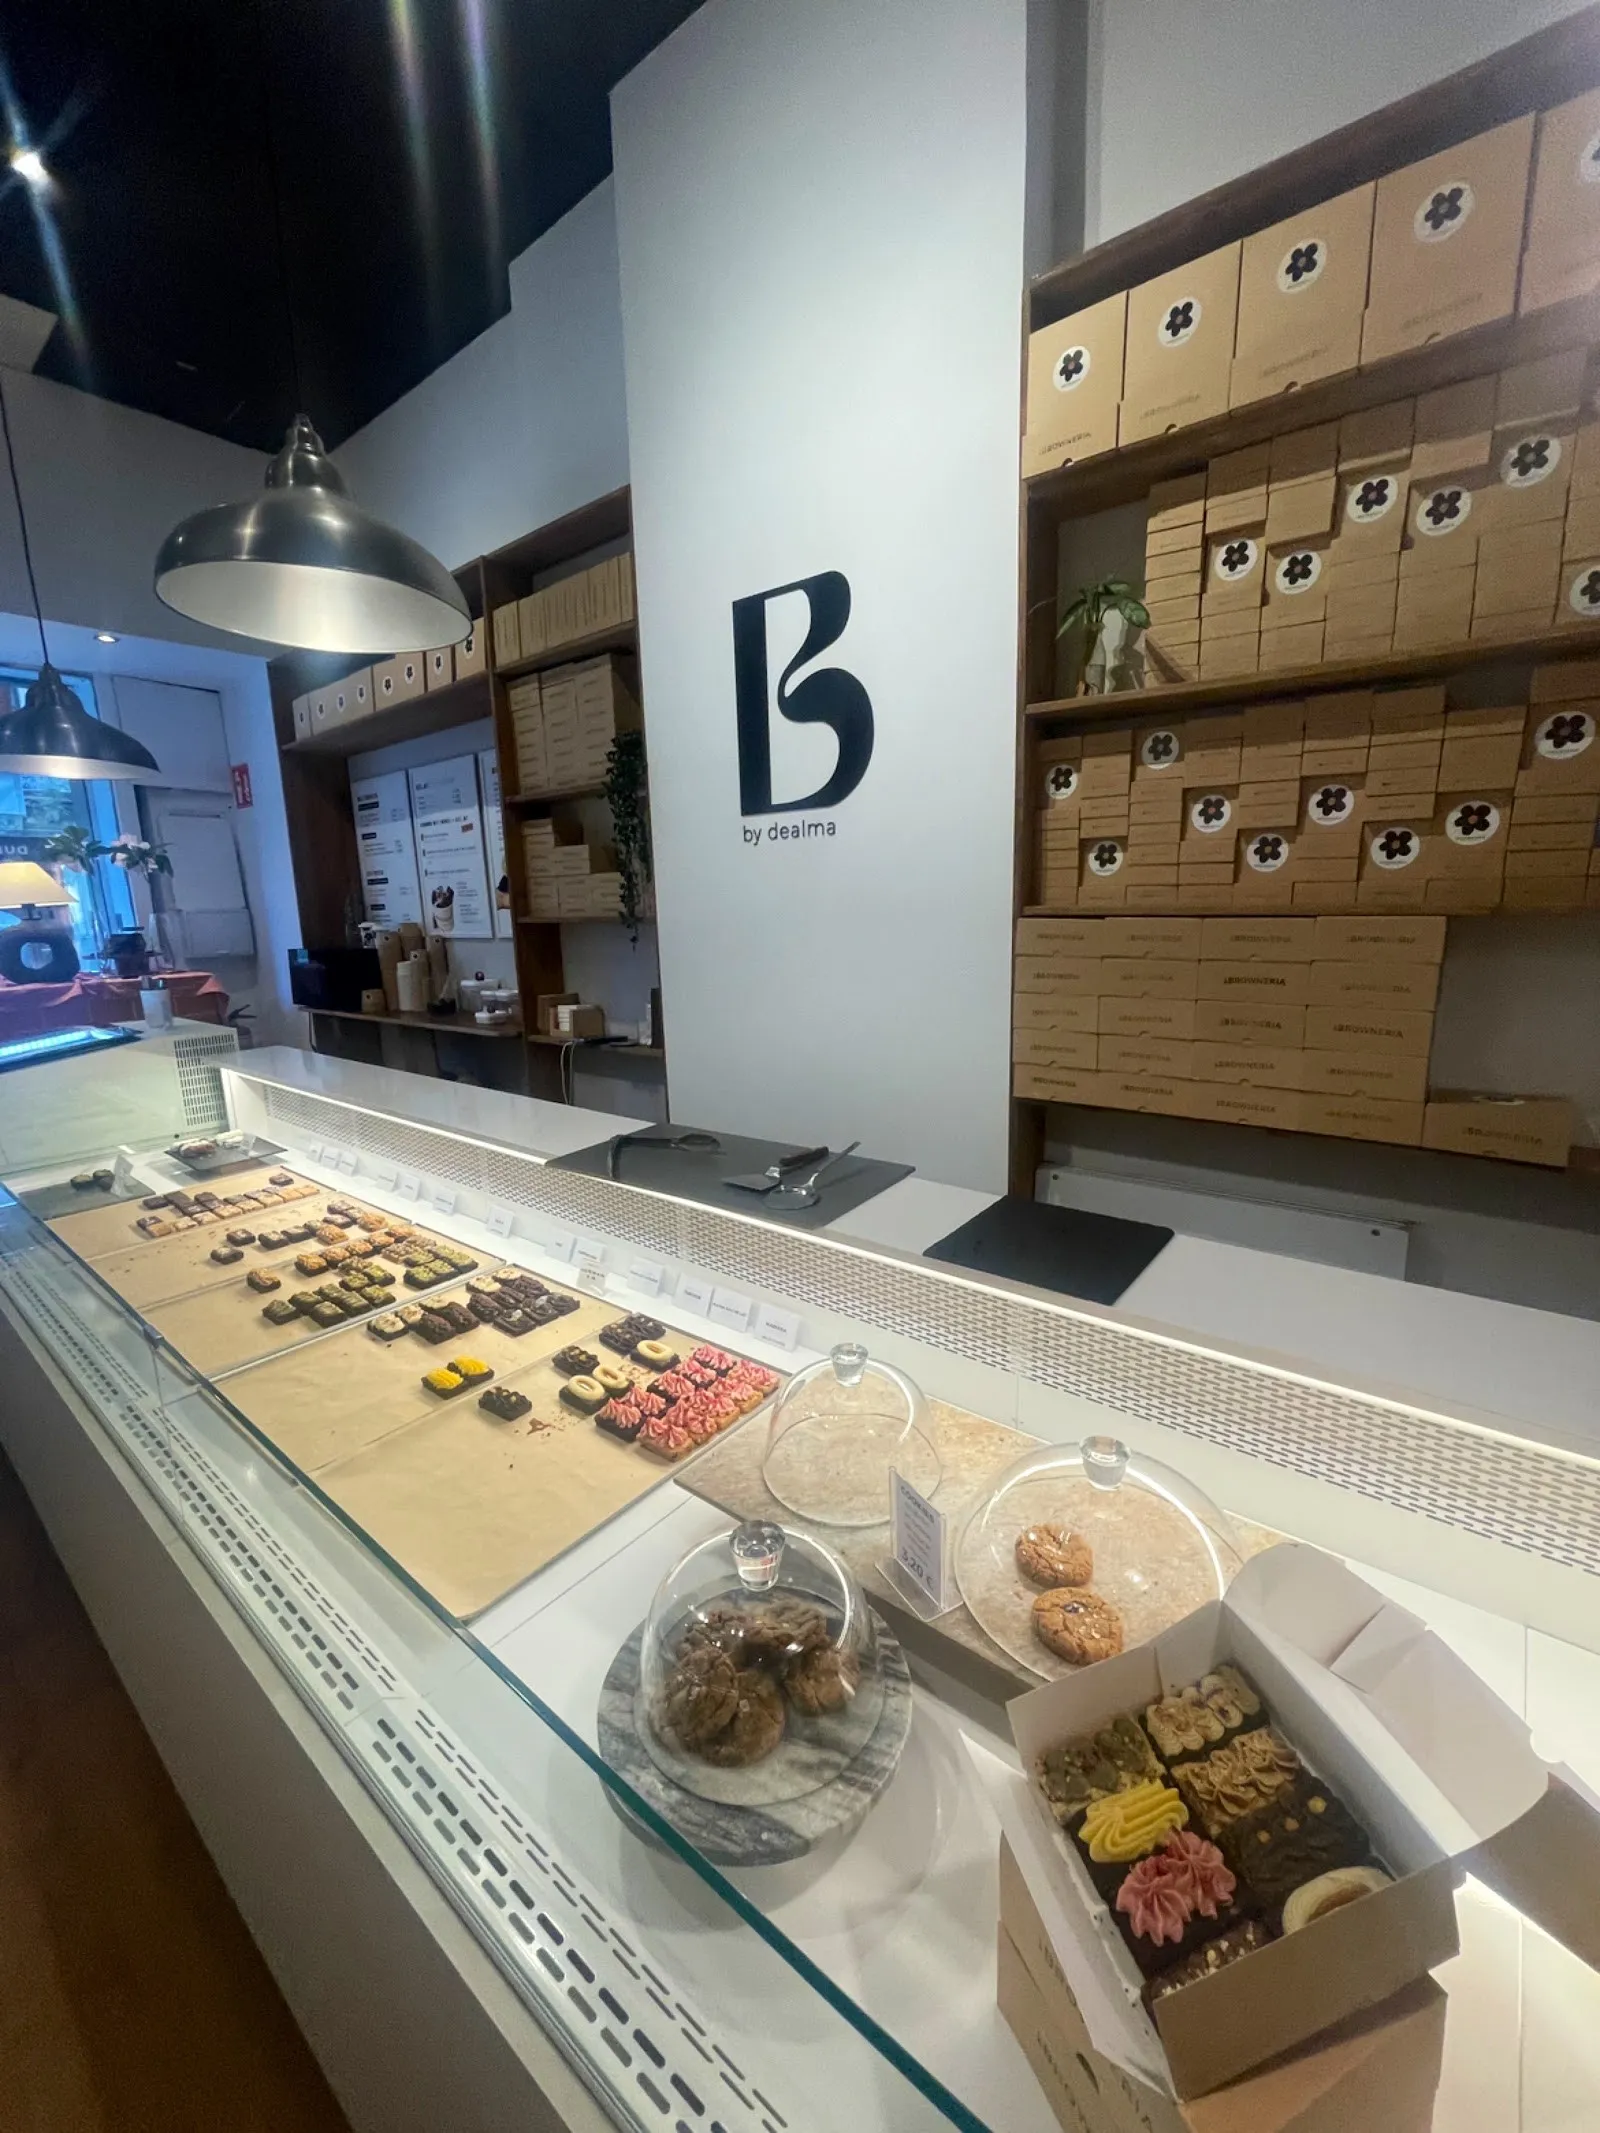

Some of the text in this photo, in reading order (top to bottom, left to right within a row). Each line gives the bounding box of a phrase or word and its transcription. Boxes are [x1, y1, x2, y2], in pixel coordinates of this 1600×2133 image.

[732, 570, 875, 817] B
[743, 820, 836, 845] by dealma
